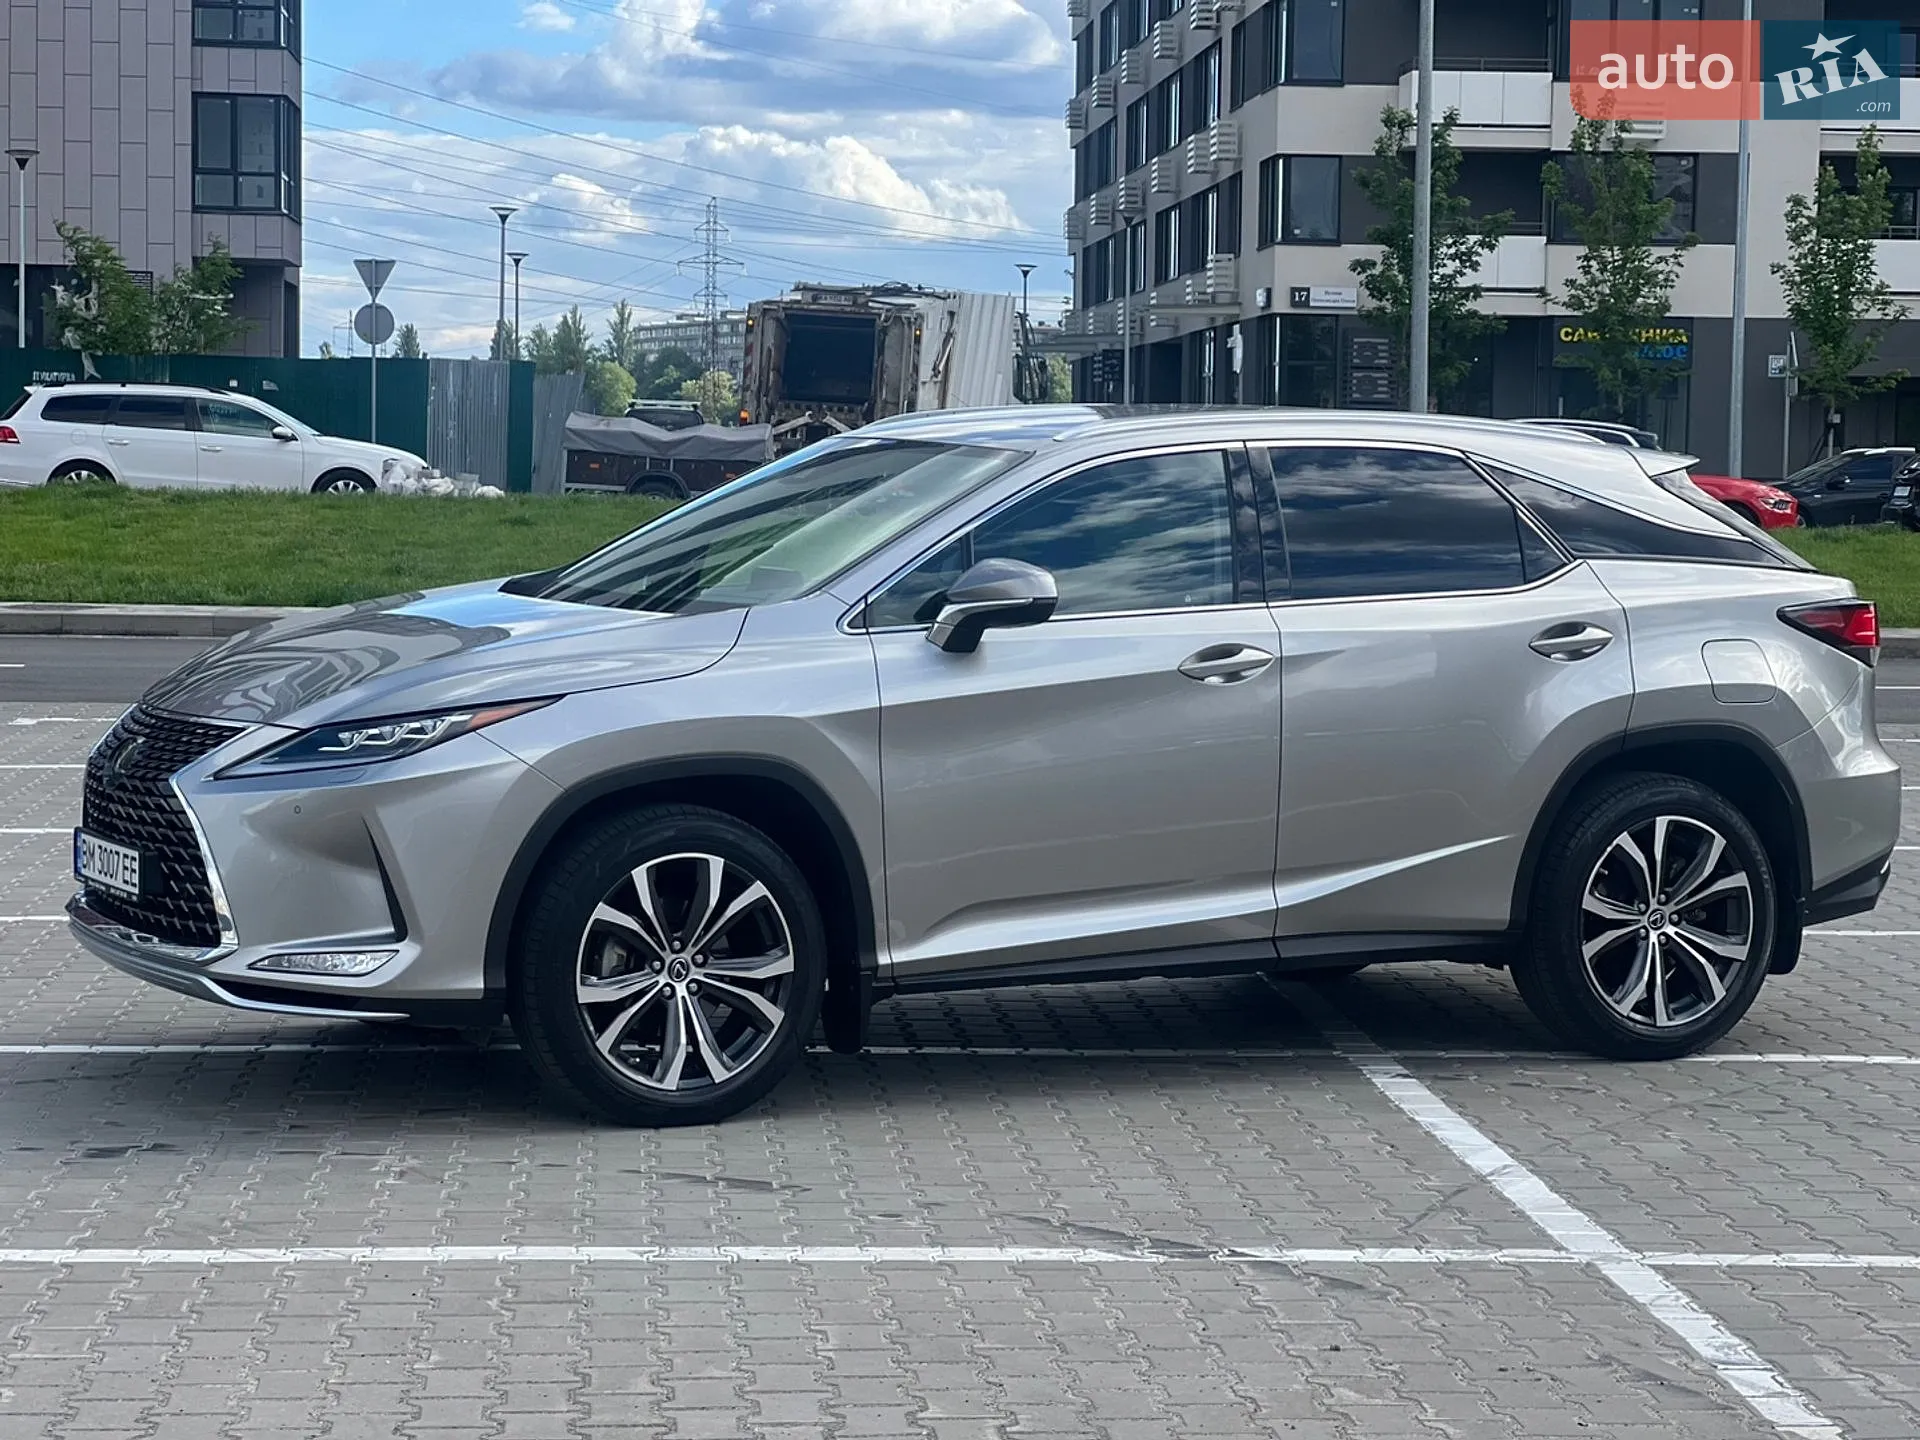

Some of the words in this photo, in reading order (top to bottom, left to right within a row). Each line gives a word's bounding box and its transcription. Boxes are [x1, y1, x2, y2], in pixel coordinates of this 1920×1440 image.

[1294, 291, 1308, 302] 17
[98, 844, 121, 881] 3007
[122, 853, 138, 889] EE
